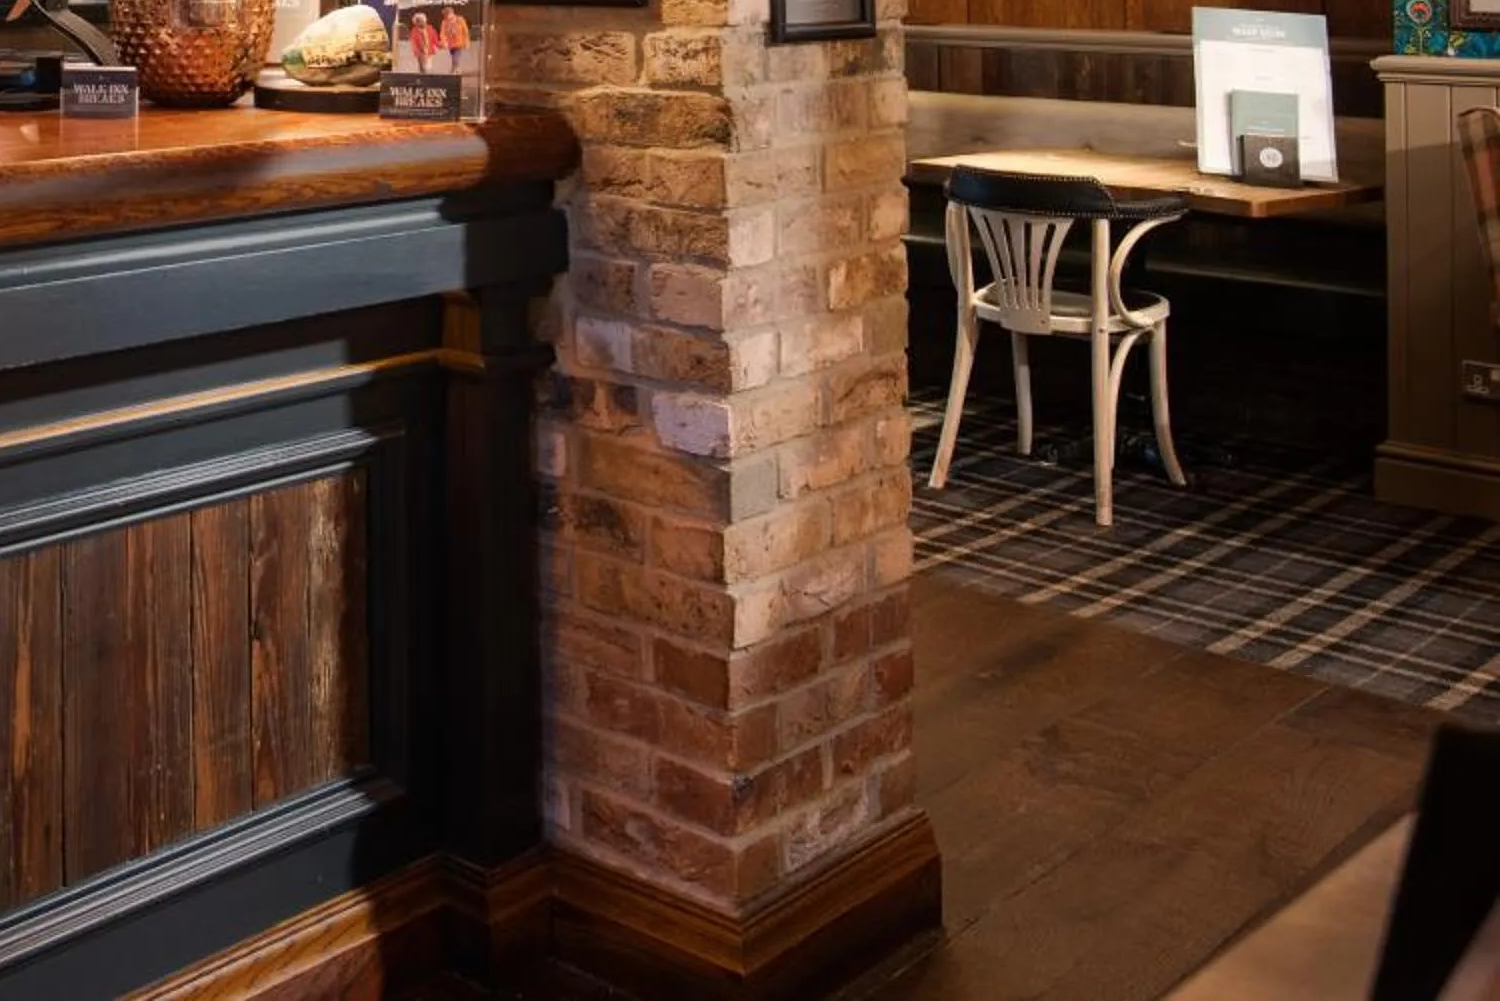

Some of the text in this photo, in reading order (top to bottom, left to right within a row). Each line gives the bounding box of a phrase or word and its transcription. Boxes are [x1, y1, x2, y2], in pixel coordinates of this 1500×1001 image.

[72, 83, 108, 95] WALK
[389, 85, 425, 98] WALK
[394, 96, 444, 108] BREAKS
